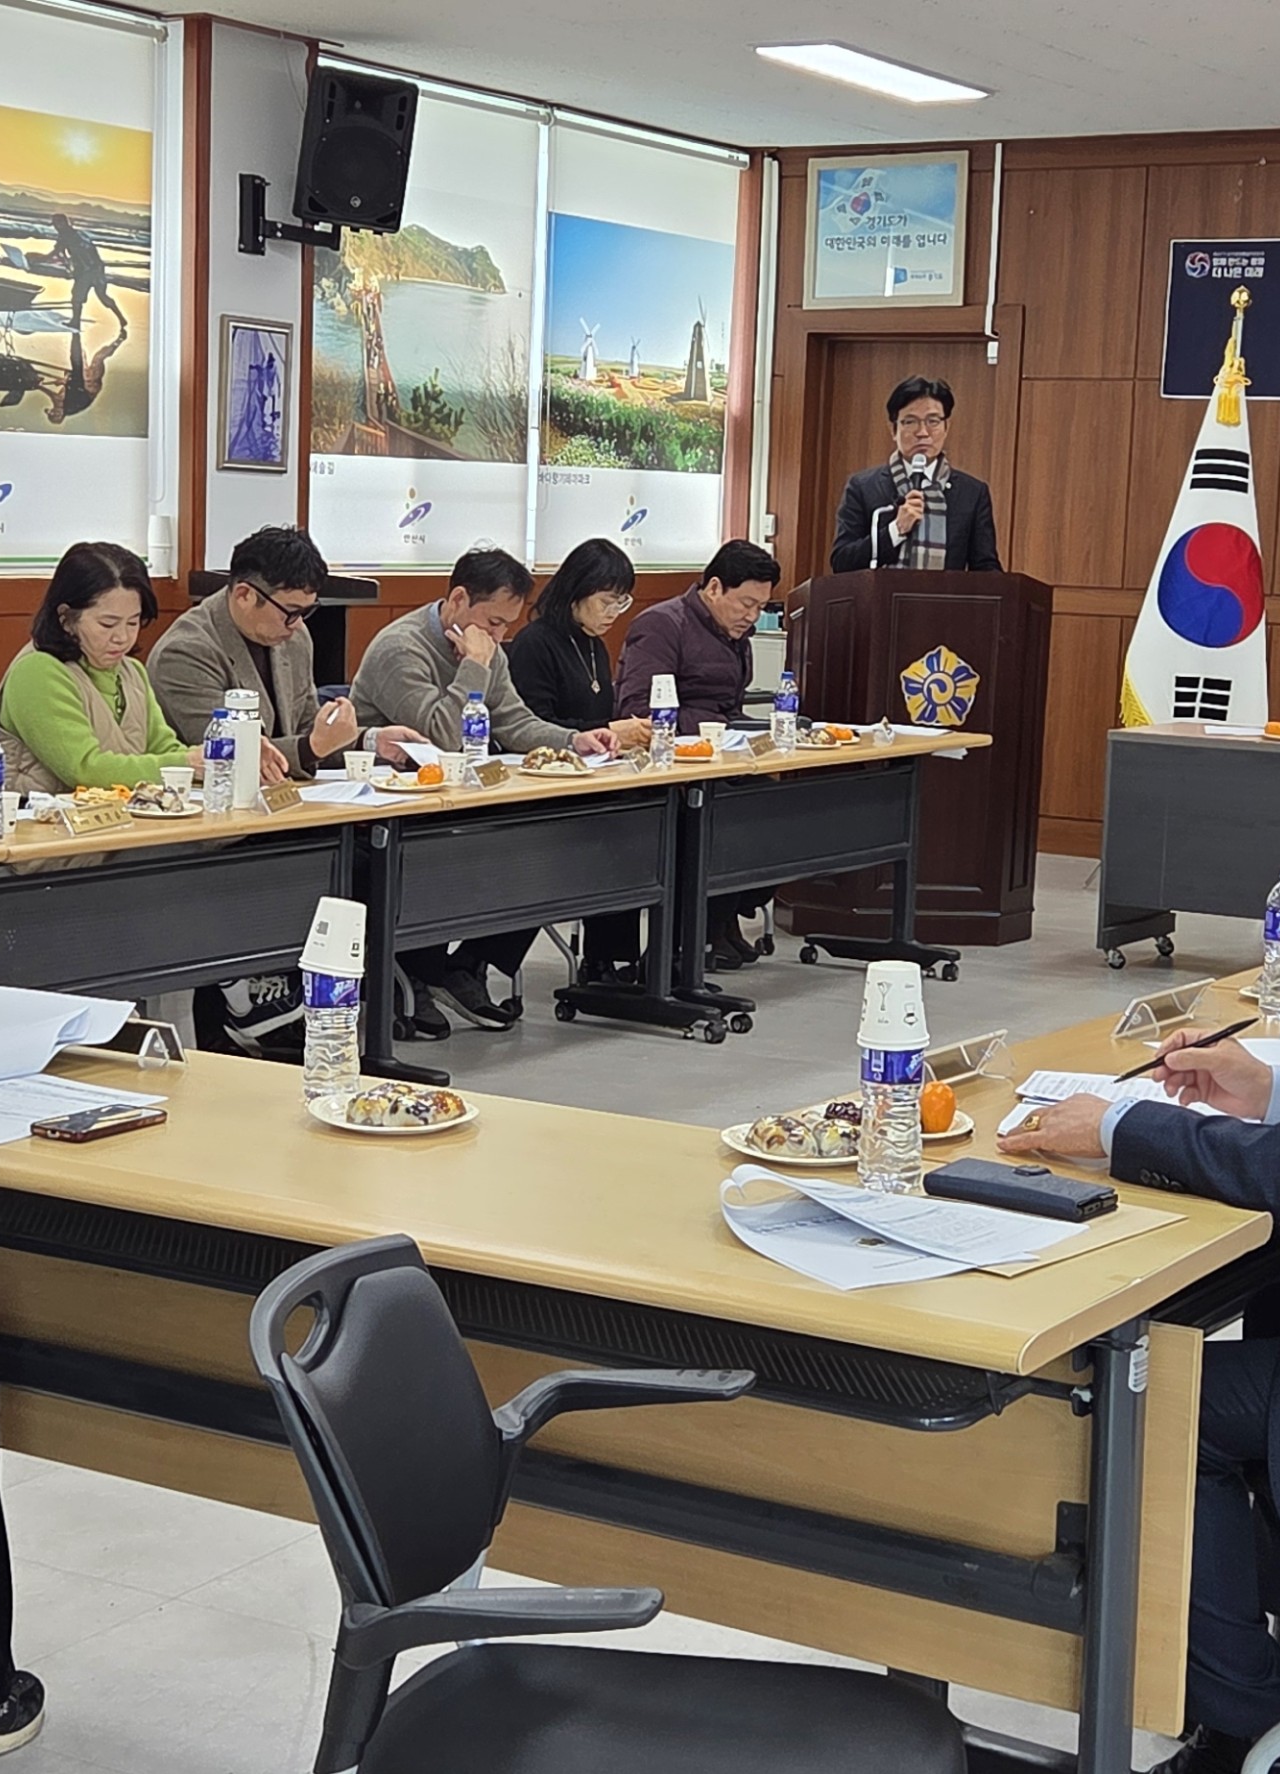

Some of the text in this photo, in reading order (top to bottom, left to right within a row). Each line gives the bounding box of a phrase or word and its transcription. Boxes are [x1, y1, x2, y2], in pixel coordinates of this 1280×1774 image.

[865, 214, 908, 231] 경기도가
[825, 235, 877, 251] 대한민국의
[915, 232, 948, 248] 엽니다
